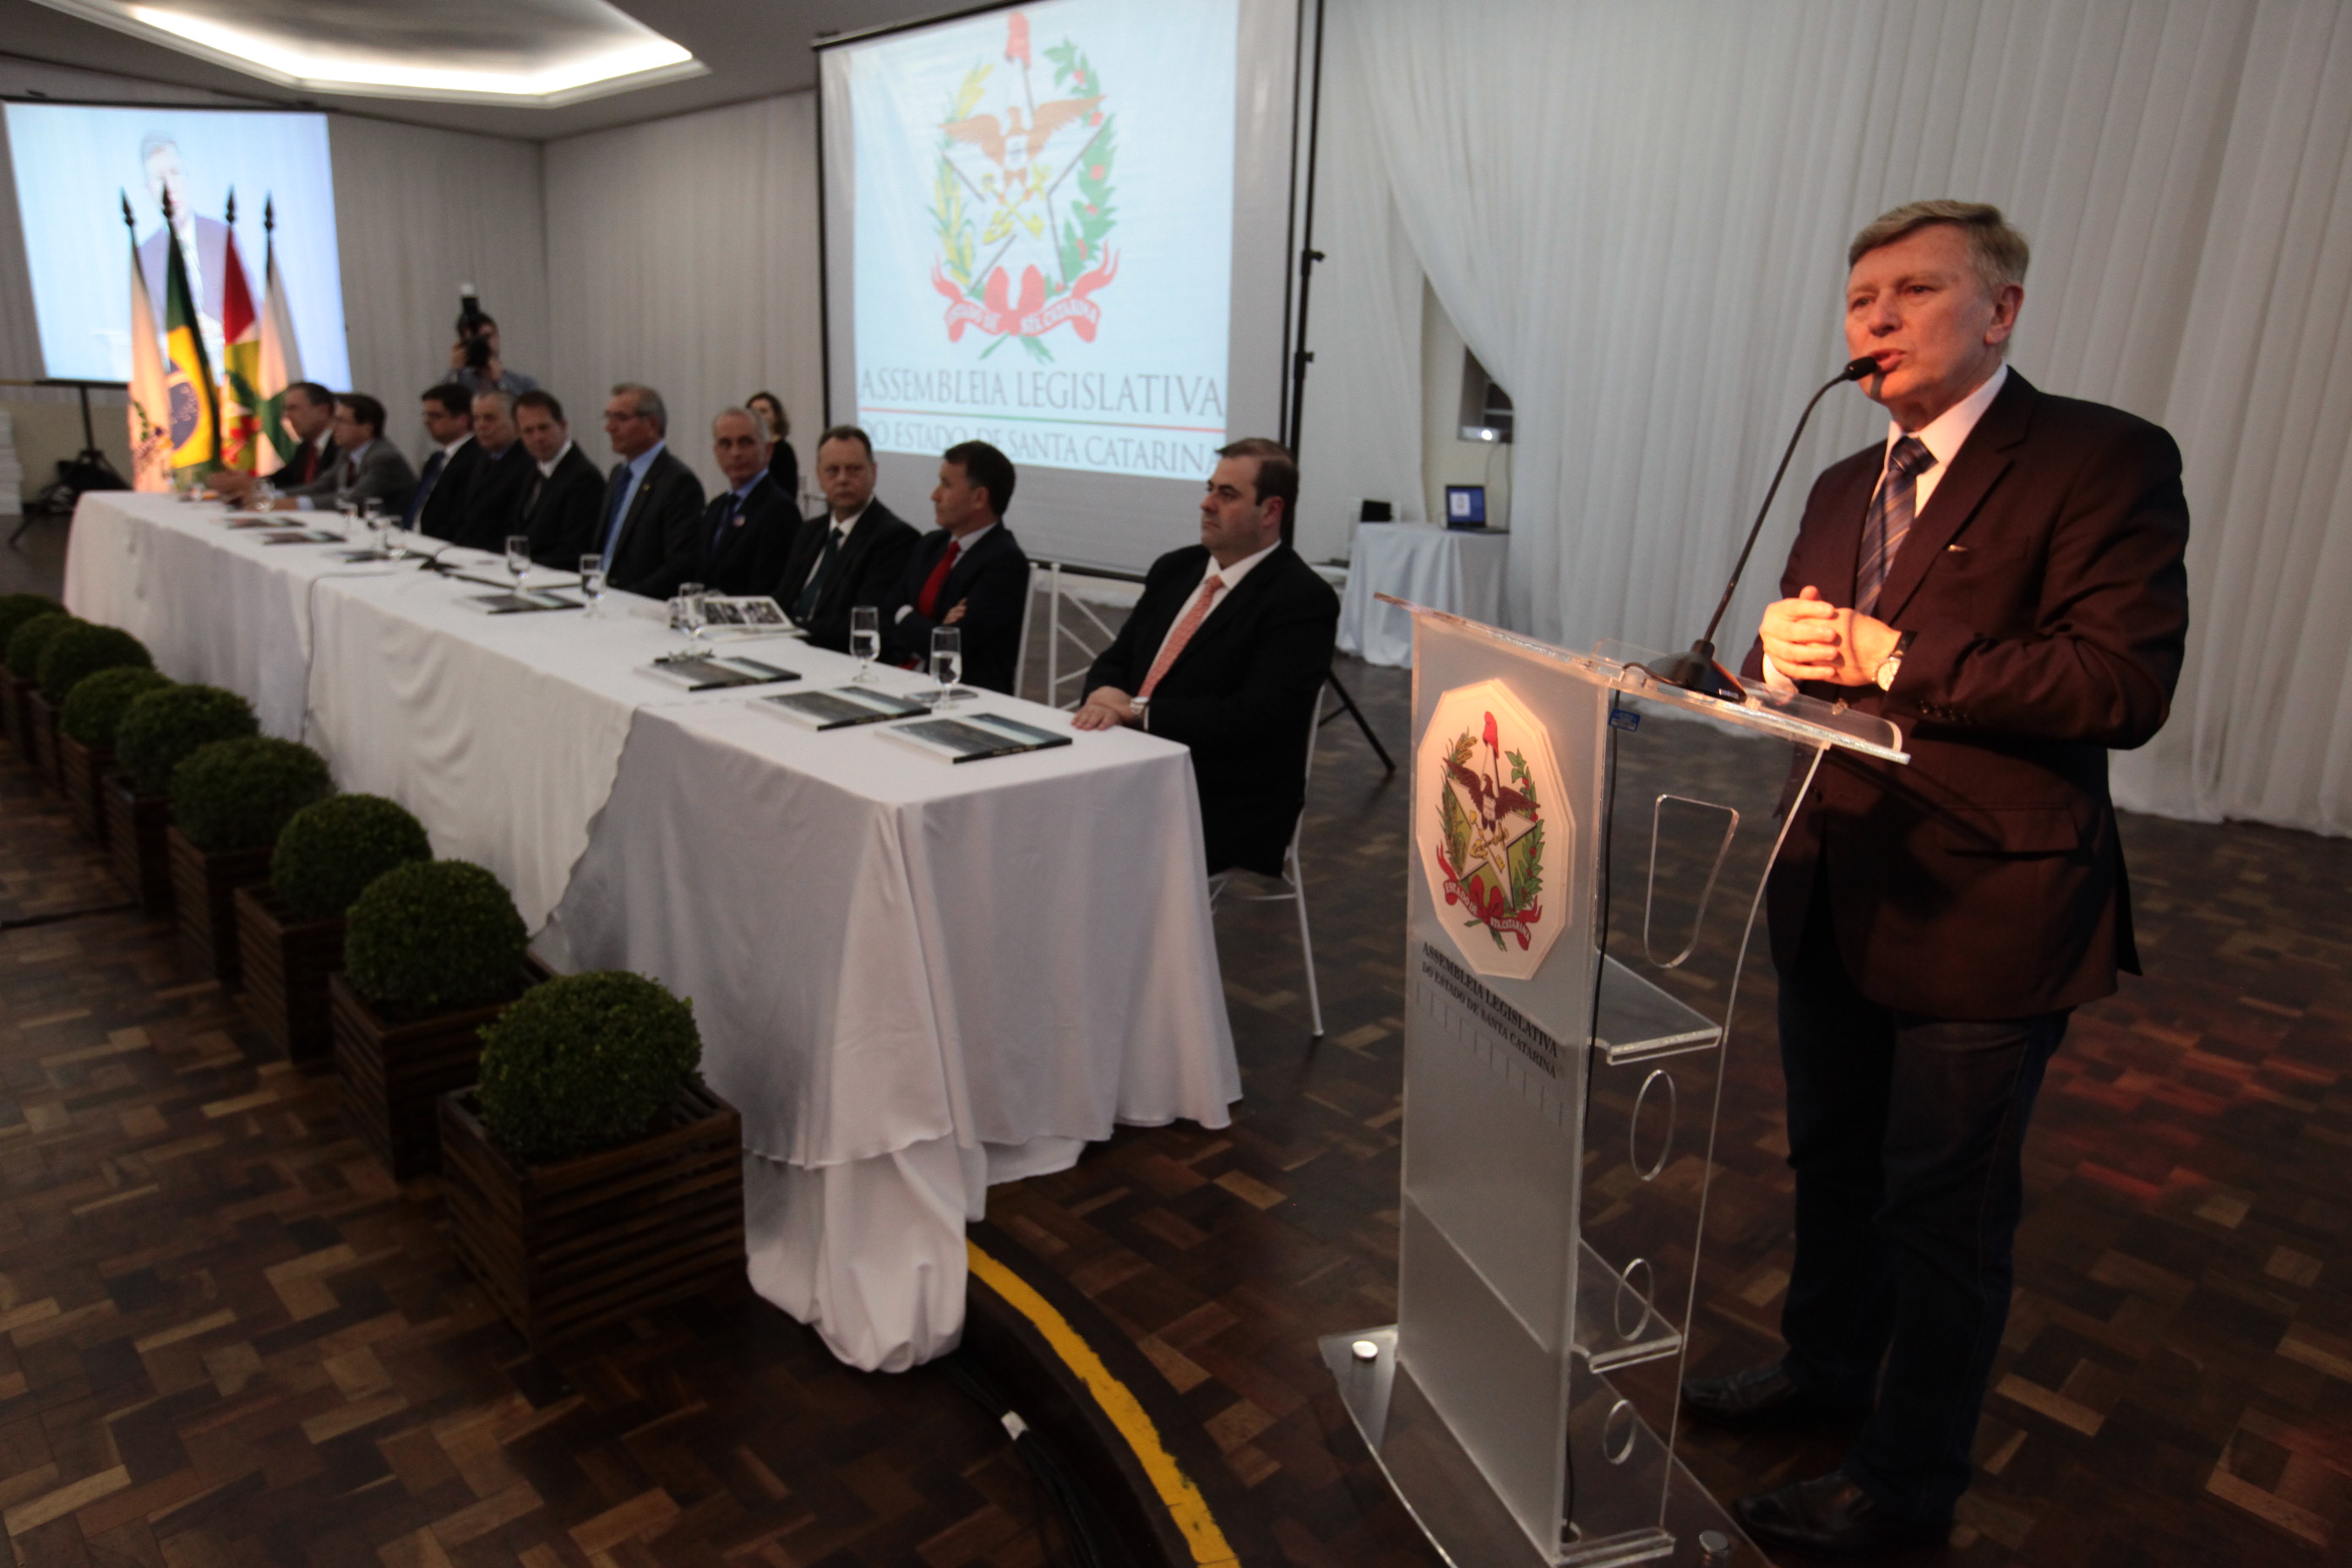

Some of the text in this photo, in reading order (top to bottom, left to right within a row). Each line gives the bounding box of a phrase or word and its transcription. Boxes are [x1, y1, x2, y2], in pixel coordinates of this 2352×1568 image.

[859, 367, 1224, 417] ASSEMBLEIA LEGISLATIVA
[895, 422, 969, 450] ESTADO
[1008, 429, 1081, 464] SANTA
[1422, 961, 1556, 1079] DO ESTADO DE SANTA CATARINA
[1423, 941, 1558, 1059] ASSEMBLEIA LEGISLATIVA
